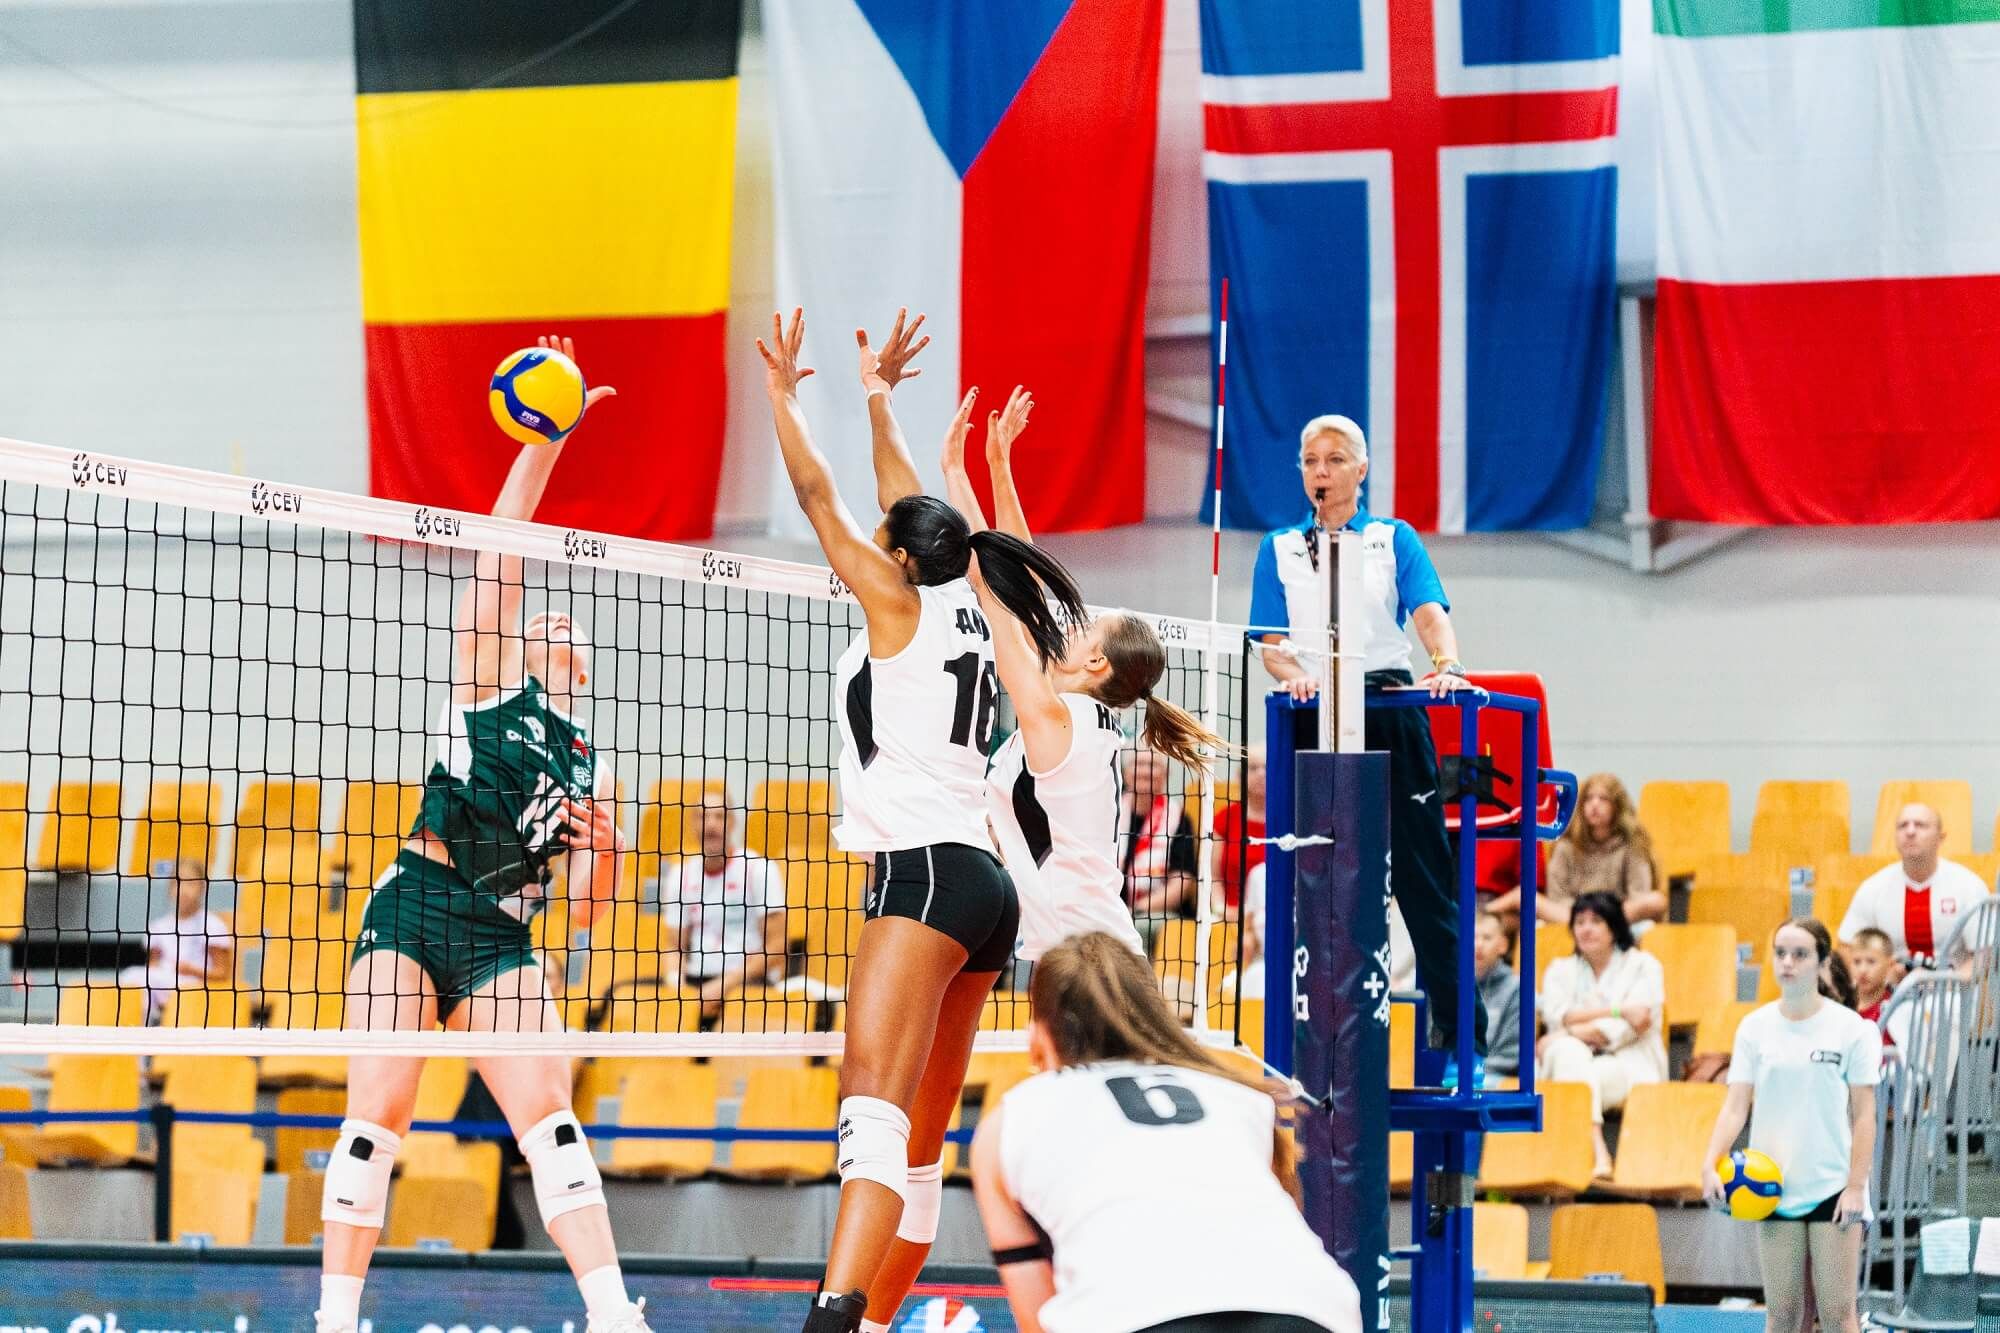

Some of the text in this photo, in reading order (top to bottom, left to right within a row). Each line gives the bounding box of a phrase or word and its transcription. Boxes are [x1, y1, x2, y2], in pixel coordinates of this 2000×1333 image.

[95, 462, 128, 487] CEV
[272, 491, 302, 513] CEV
[433, 515, 461, 537] CEV
[581, 538, 607, 559] CEV
[718, 560, 742, 579] CEV
[1170, 624, 1188, 641] CEV
[1105, 1076, 1204, 1126] 6
